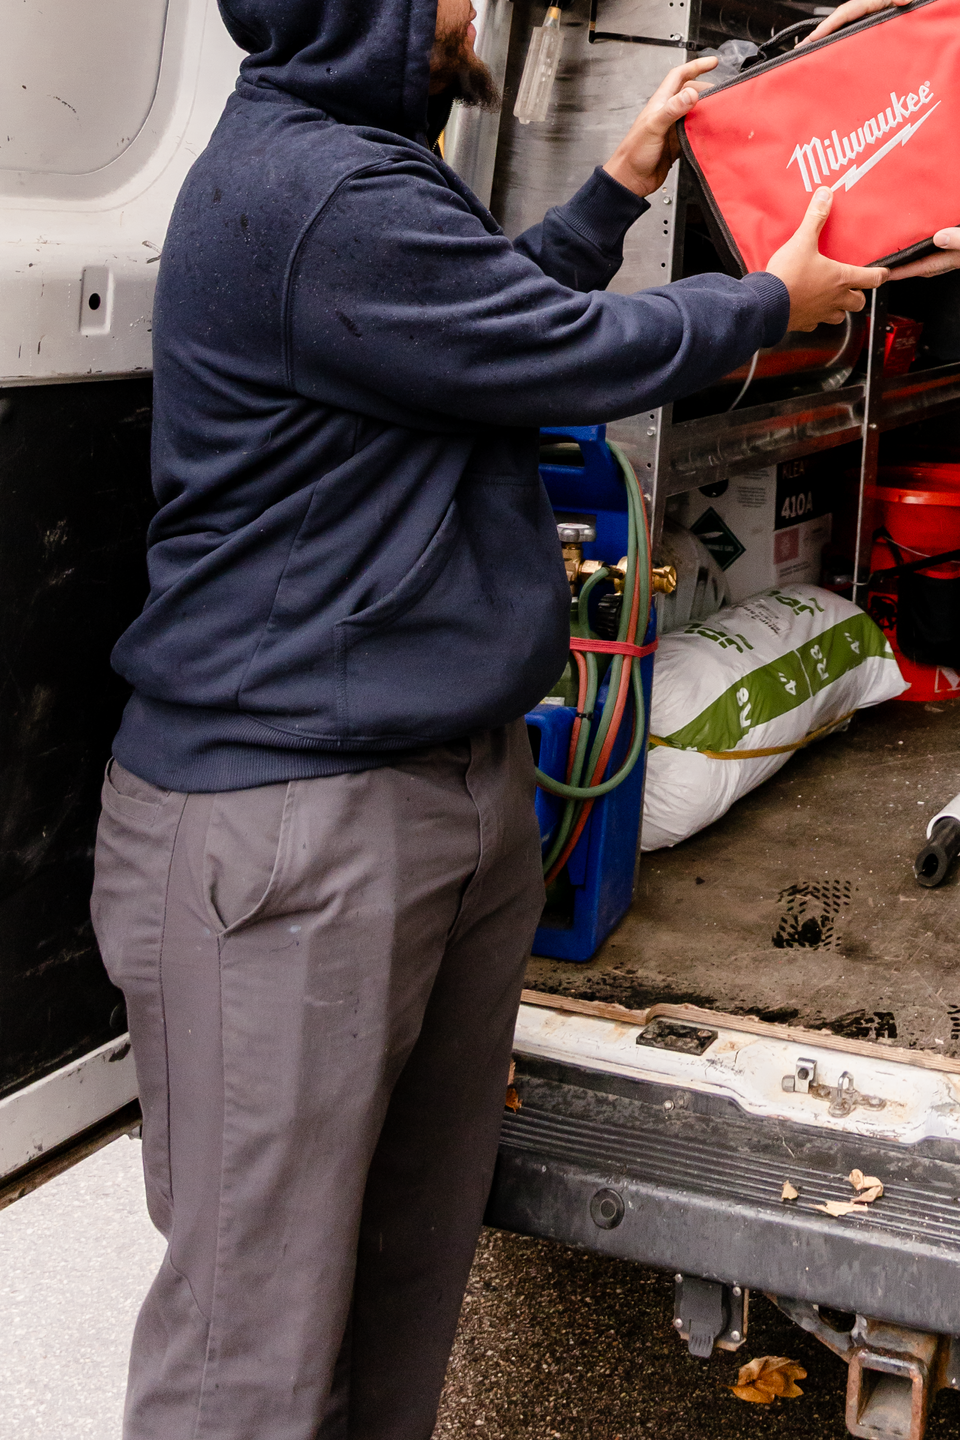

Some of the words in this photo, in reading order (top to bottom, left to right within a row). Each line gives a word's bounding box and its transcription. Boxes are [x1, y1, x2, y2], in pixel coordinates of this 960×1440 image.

[786, 84, 934, 192] Milwaukee
[781, 491, 814, 519] 410A
[810, 644, 829, 680] R8
[736, 687, 752, 728] R8
